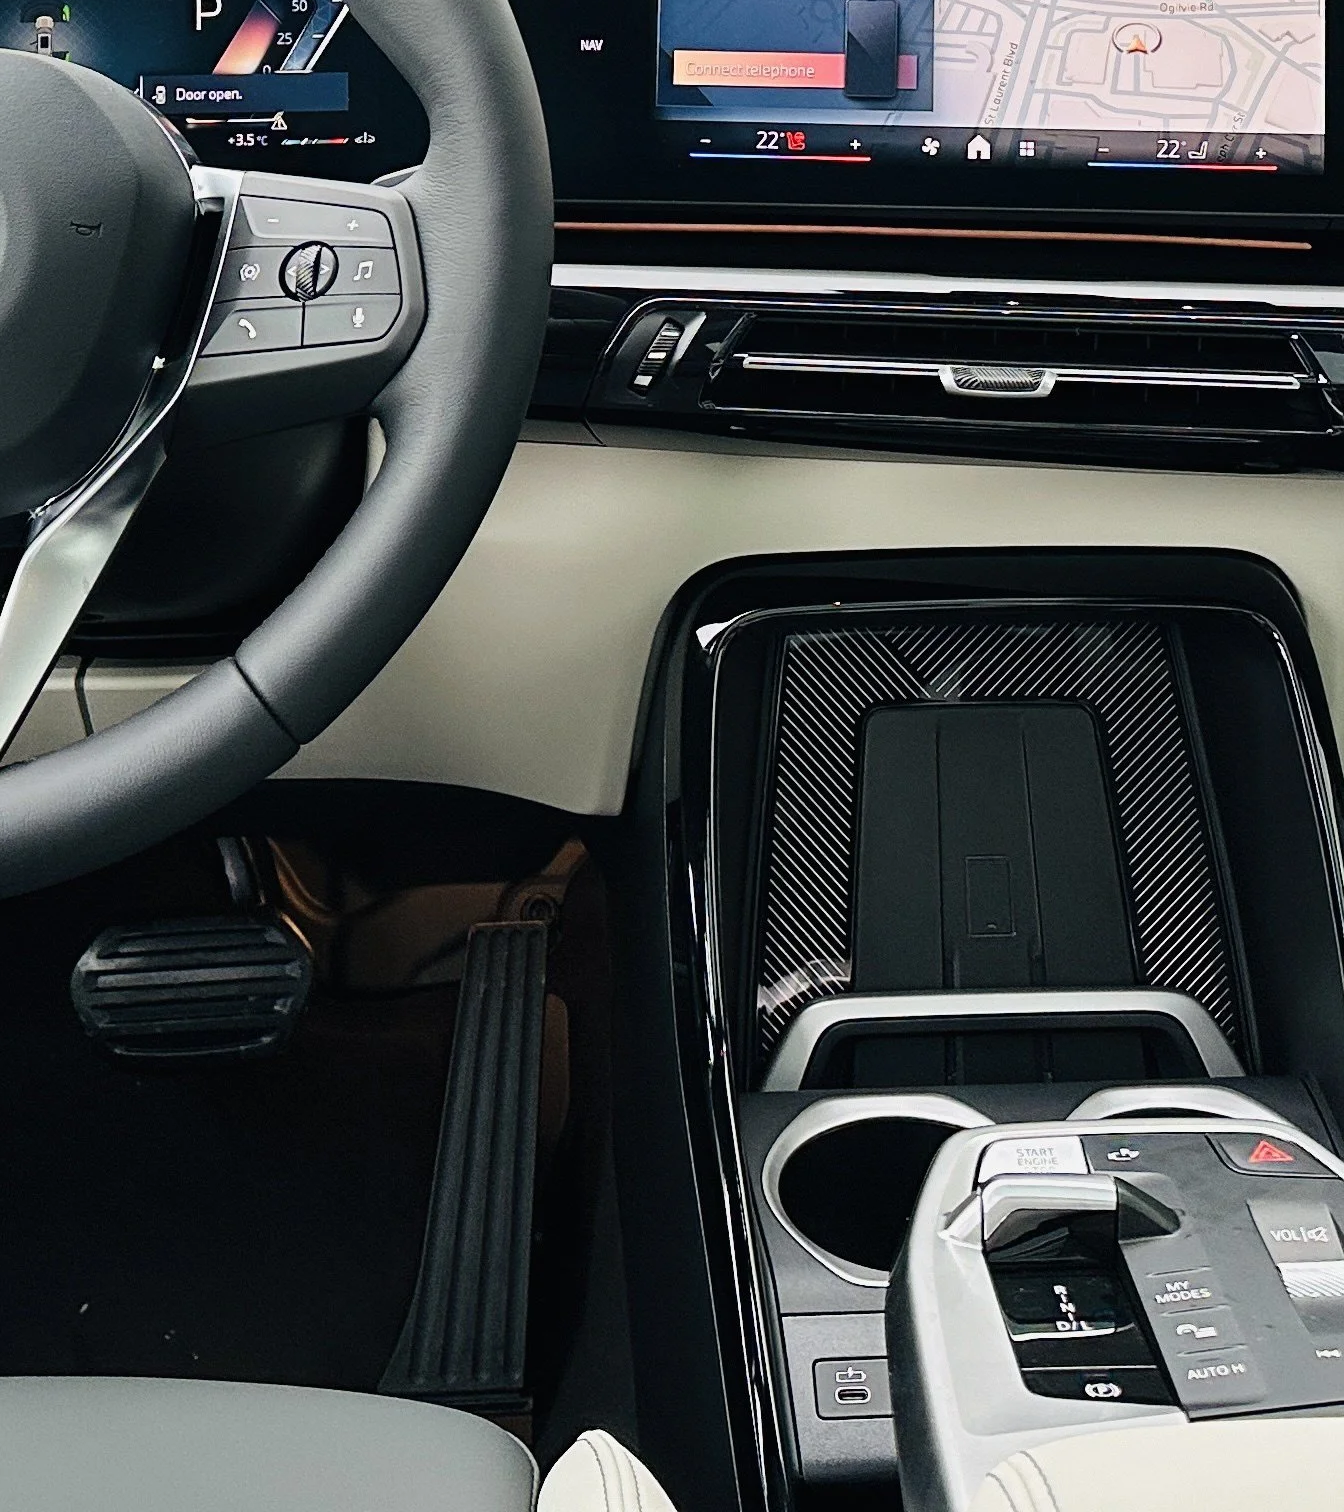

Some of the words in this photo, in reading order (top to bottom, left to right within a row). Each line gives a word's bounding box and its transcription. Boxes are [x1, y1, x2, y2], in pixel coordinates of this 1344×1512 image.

[291, 0, 308, 12] 50
[1159, 2, 1197, 15] Ogilvie
[1199, 2, 1214, 12] Rd
[276, 32, 293, 45] 25
[580, 39, 603, 51] NAV
[685, 61, 744, 76] Connect
[746, 62, 816, 79] telephone
[175, 88, 206, 101] Door
[208, 90, 243, 103] open.
[228, 133, 255, 147] +3.5
[1016, 1147, 1054, 1157] START
[1269, 1228, 1302, 1242] VOL
[1165, 1280, 1190, 1292] MY
[1155, 1287, 1212, 1304] MODES
[1187, 1365, 1230, 1380] AUTO
[1231, 1363, 1246, 1375] H
